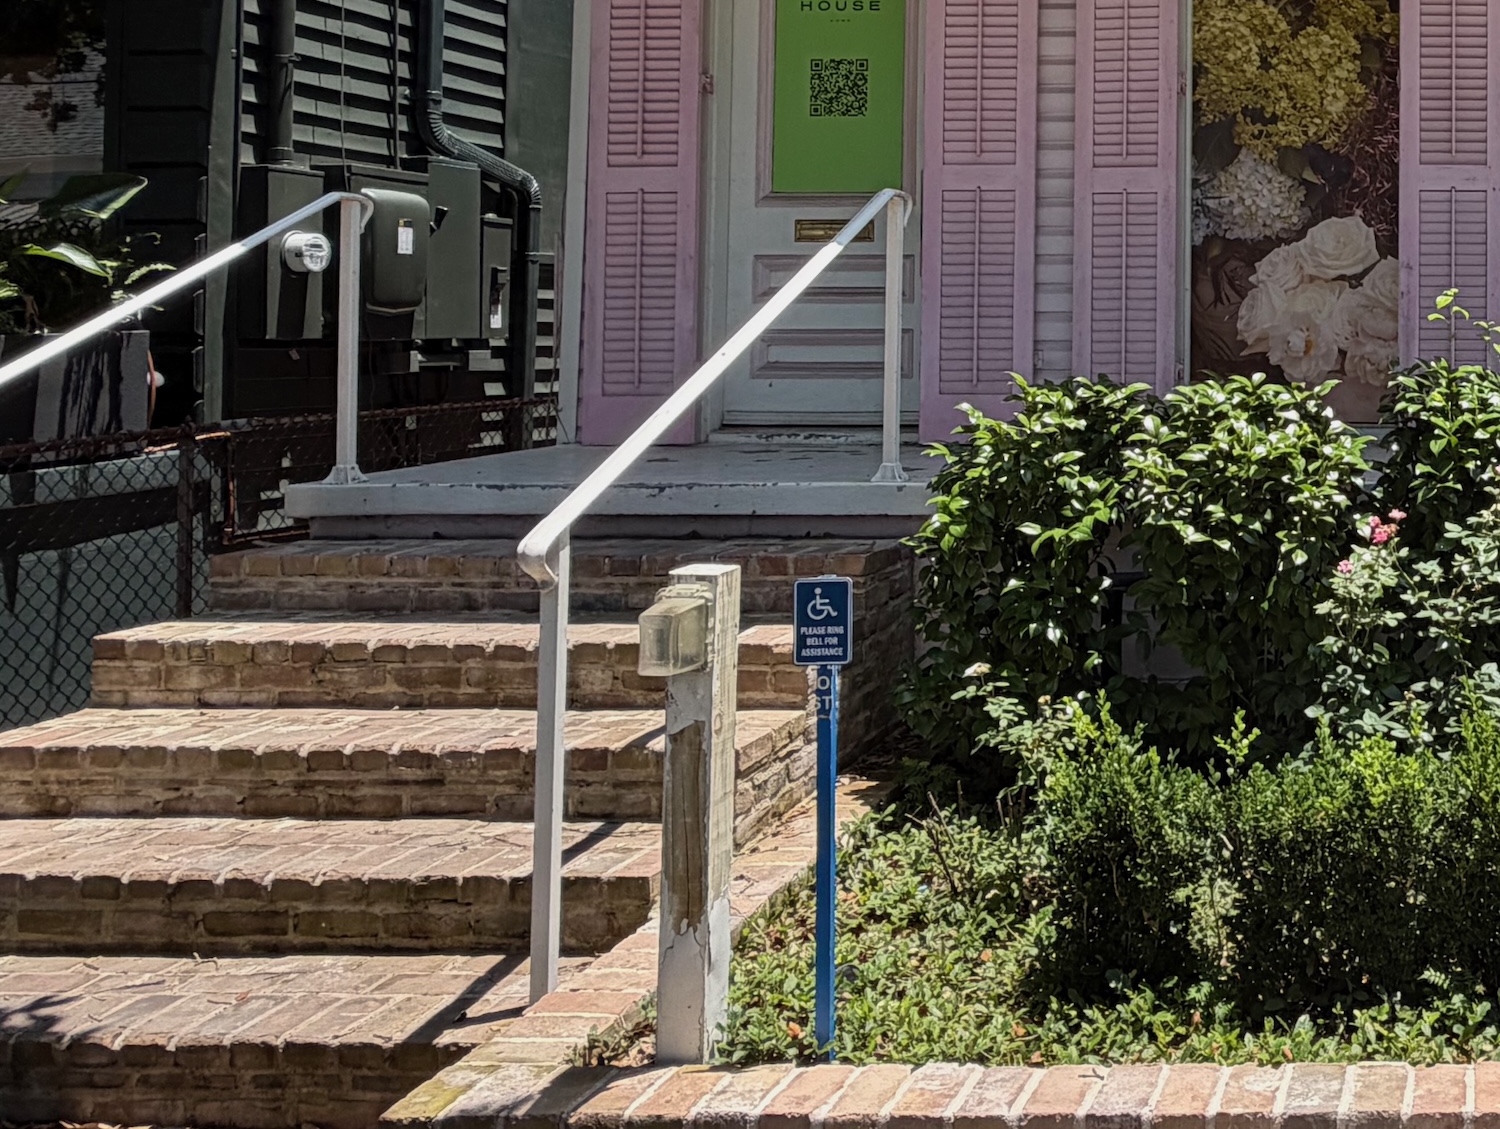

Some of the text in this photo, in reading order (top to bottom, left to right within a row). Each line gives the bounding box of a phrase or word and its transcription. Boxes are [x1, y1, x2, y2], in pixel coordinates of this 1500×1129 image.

[800, 0, 881, 12] HOUSE
[800, 626, 844, 635] PLEASE RING
[806, 636, 838, 645] BELL FOR
[801, 648, 843, 656] ASSISTANCE
